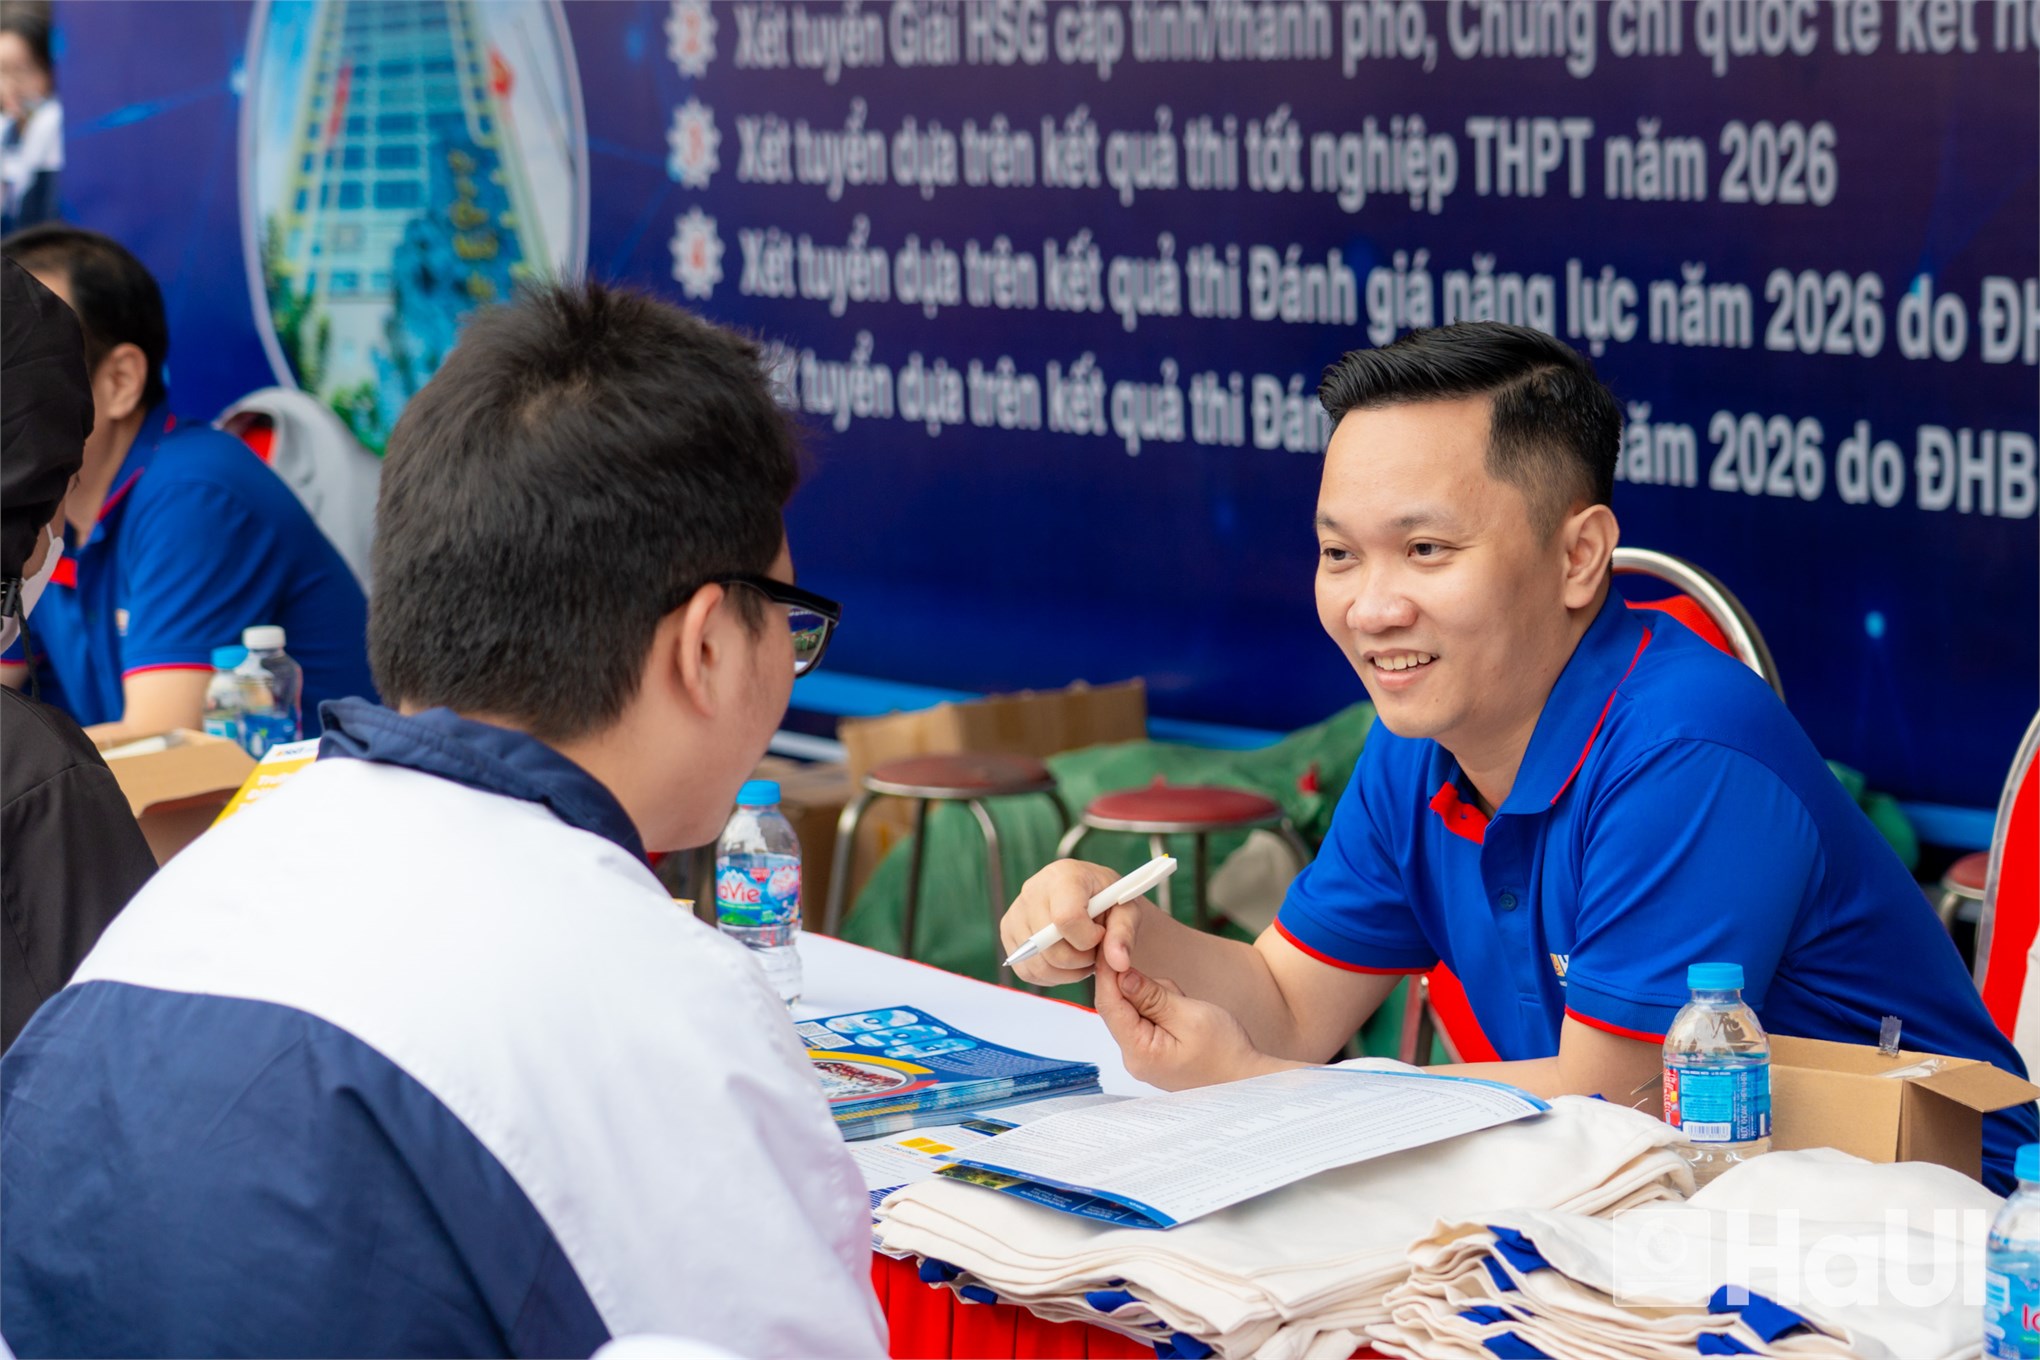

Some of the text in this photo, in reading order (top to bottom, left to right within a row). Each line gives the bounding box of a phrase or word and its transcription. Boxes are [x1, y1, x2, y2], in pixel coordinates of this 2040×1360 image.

[963, 0, 1049, 64] HSG
[736, 116, 792, 183] Xét
[795, 98, 887, 201] tuyển
[892, 118, 958, 198] dựa
[961, 115, 1034, 187] trên
[1042, 106, 1100, 188] kết
[1105, 106, 1178, 206] quả
[1183, 116, 1238, 189] thi
[1245, 105, 1303, 192] tốt
[1311, 115, 1457, 214] nghiệp
[1466, 117, 1593, 197] THPT
[1605, 115, 1706, 201] năm
[1720, 121, 1837, 205] 2026
[739, 229, 796, 297] Xét
[798, 215, 890, 316] tuyển
[894, 235, 960, 318] dựa
[964, 236, 1038, 308] trên
[1044, 230, 1103, 312] kết
[1108, 233, 1181, 331] quả
[1186, 245, 1241, 318] thi
[1248, 244, 1356, 325] Đánh
[1366, 250, 1434, 345] giá
[1567, 259, 1637, 356] lực
[1649, 261, 1752, 348] năm
[1766, 269, 1883, 357] 2026
[1898, 274, 1967, 361] do
[802, 331, 893, 431] tuyển
[898, 354, 964, 435] dựa
[967, 357, 1041, 429] trên
[1047, 353, 1106, 435] kết
[1112, 359, 1184, 455] quả
[1189, 372, 1244, 446] thi
[1709, 411, 1824, 500] 2026
[1836, 421, 1904, 507] do
